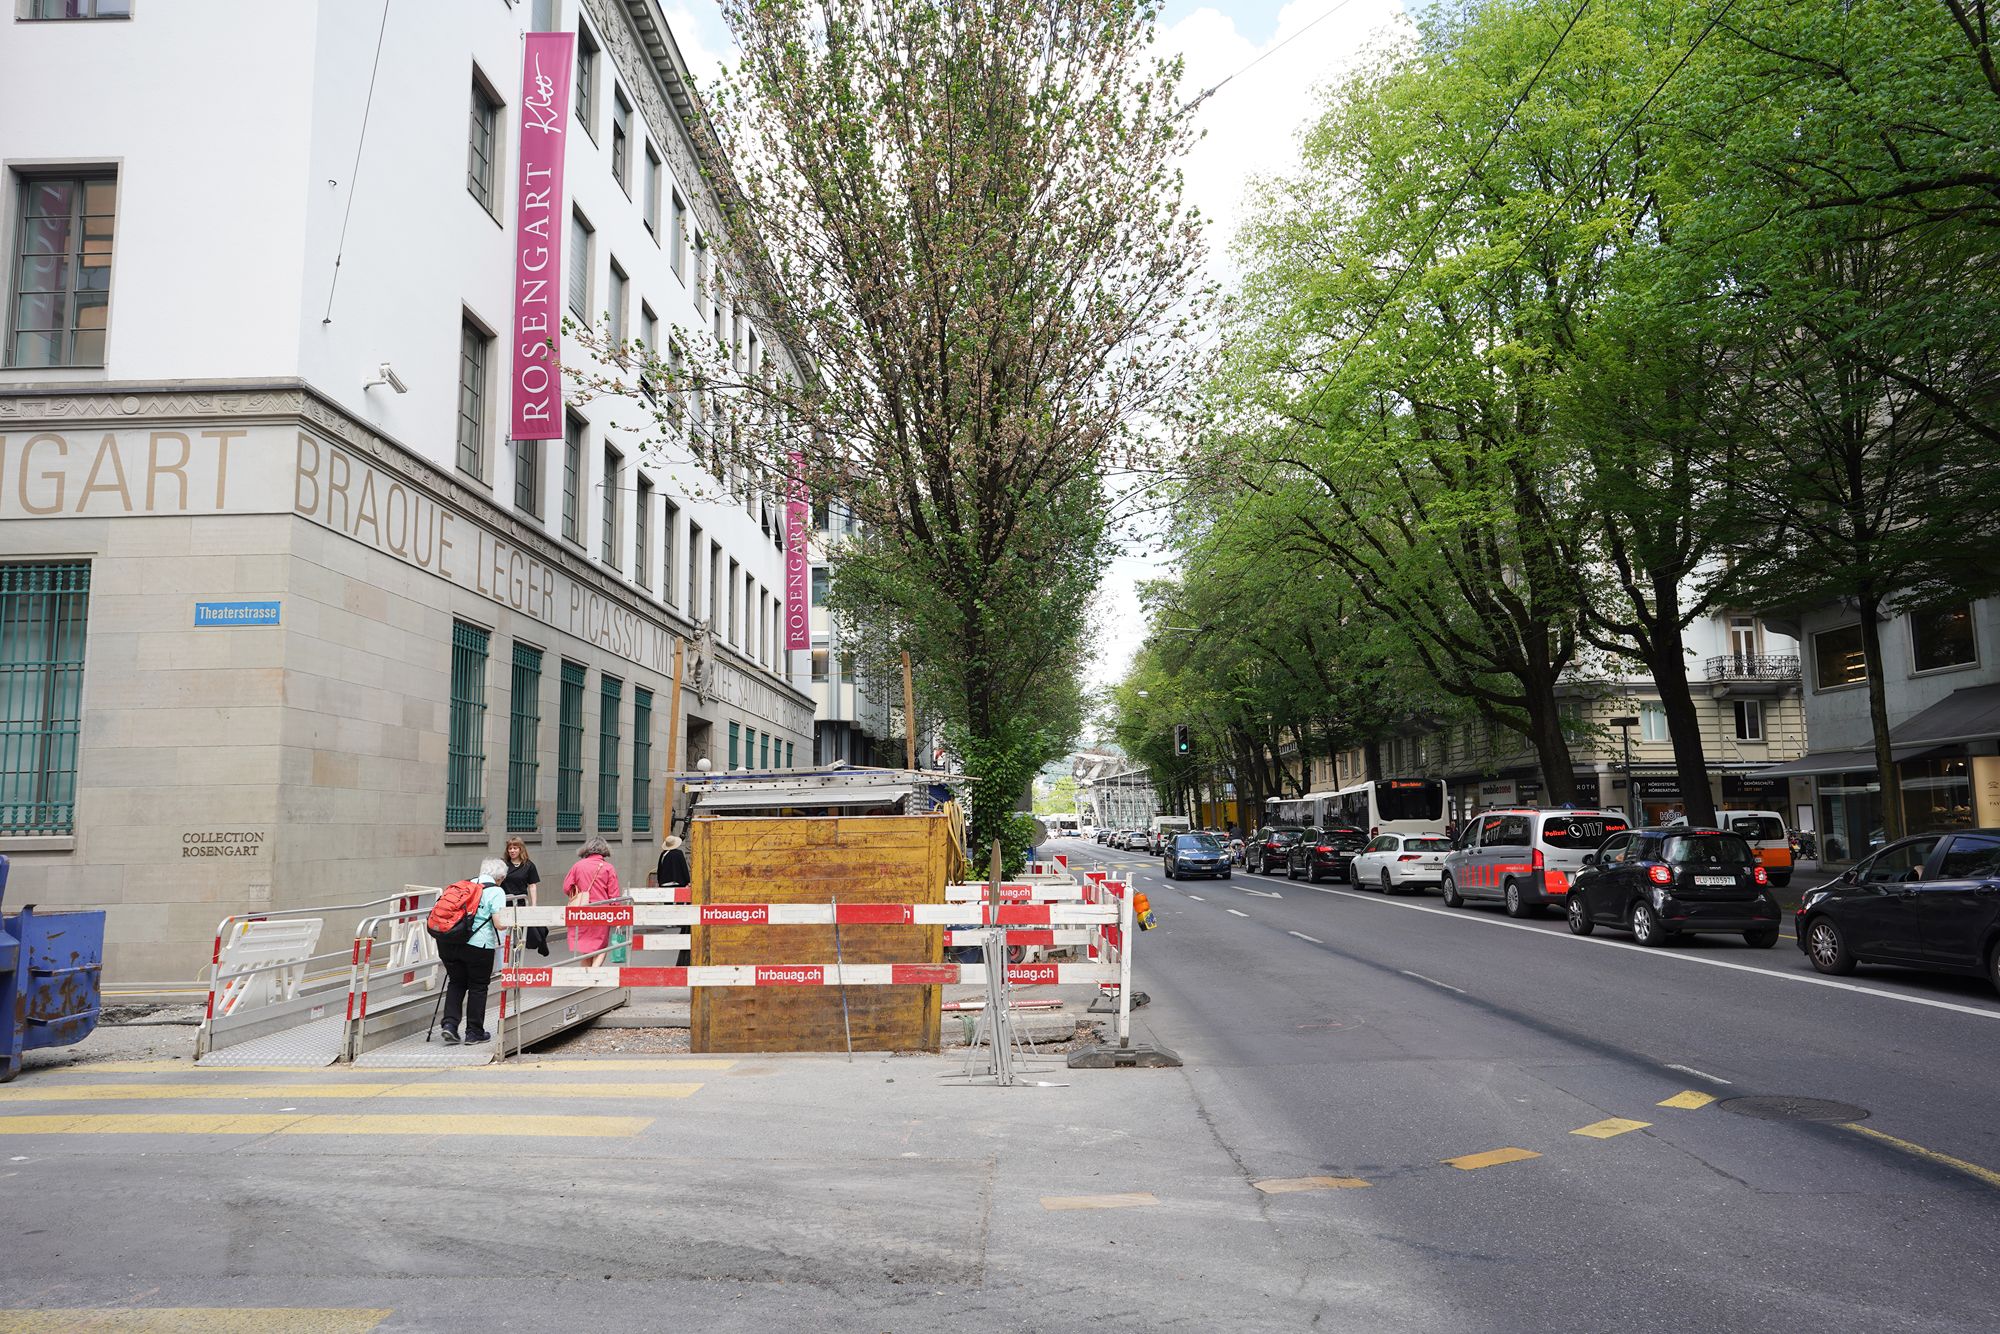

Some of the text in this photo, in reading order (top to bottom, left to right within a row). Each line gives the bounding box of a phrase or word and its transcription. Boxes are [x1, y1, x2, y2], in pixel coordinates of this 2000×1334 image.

[522, 163, 551, 422] ROSENGART
[295, 431, 676, 676] BRAQUE LEGER PICASSO MIR
[789, 518, 804, 642] ROSENGART
[199, 606, 277, 620] Theaterstrasse
[1544, 829, 1567, 837] Polizei
[1582, 822, 1603, 837] 117
[182, 831, 264, 843] COLLECTION
[182, 845, 259, 857] ROSENGART
[568, 909, 631, 922] hrbauag.ch
[703, 908, 766, 921] hrbauag.ch
[758, 969, 821, 982] hrbauag.ch
